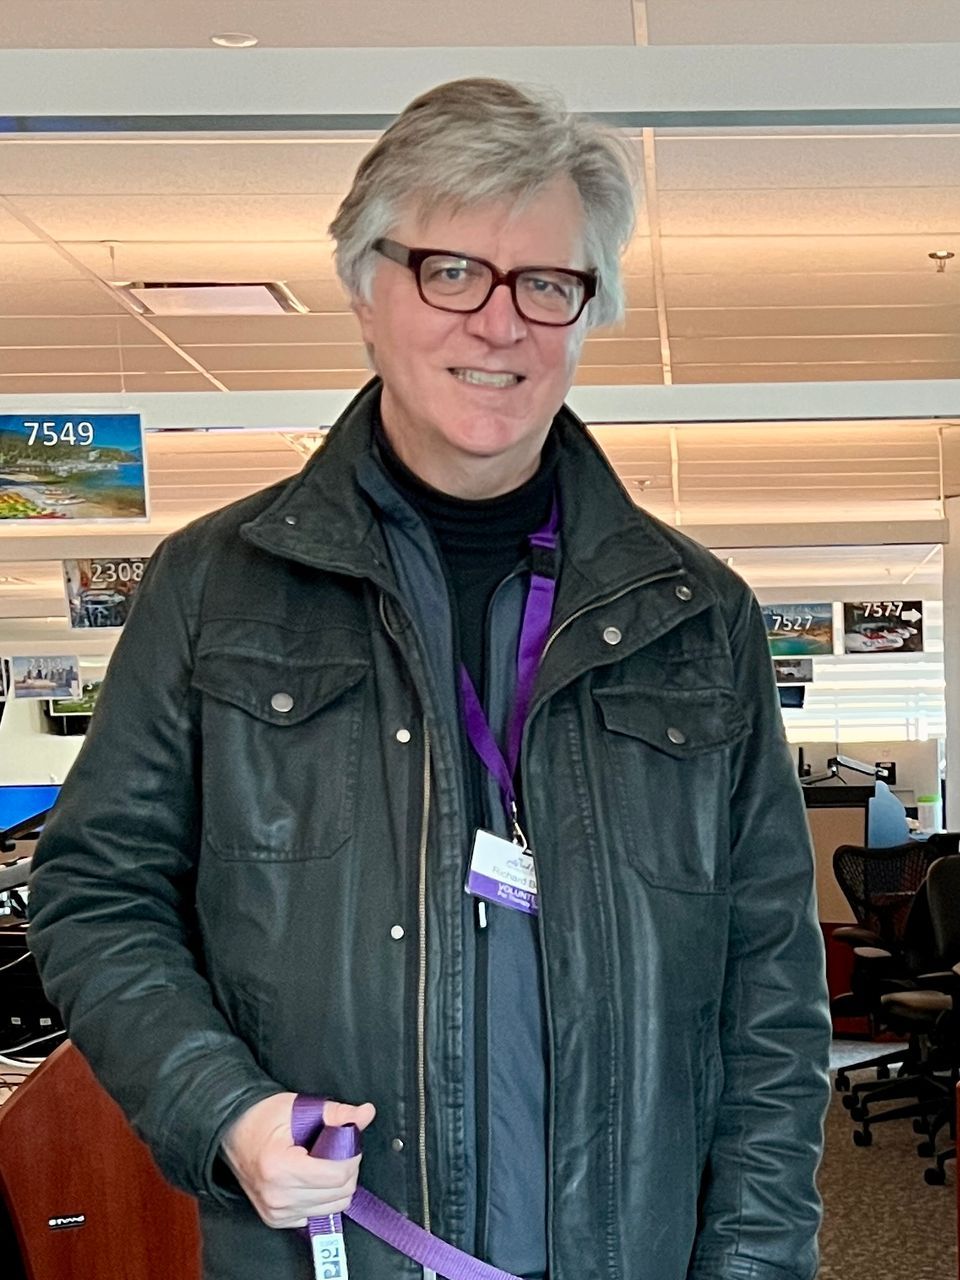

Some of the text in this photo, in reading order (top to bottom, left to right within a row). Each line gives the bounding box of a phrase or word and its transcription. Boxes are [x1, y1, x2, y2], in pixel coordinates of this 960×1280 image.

[24, 422, 94, 446] 7549
[91, 562, 144, 582] 2308
[862, 602, 903, 618] 7577
[772, 615, 813, 631] 7527
